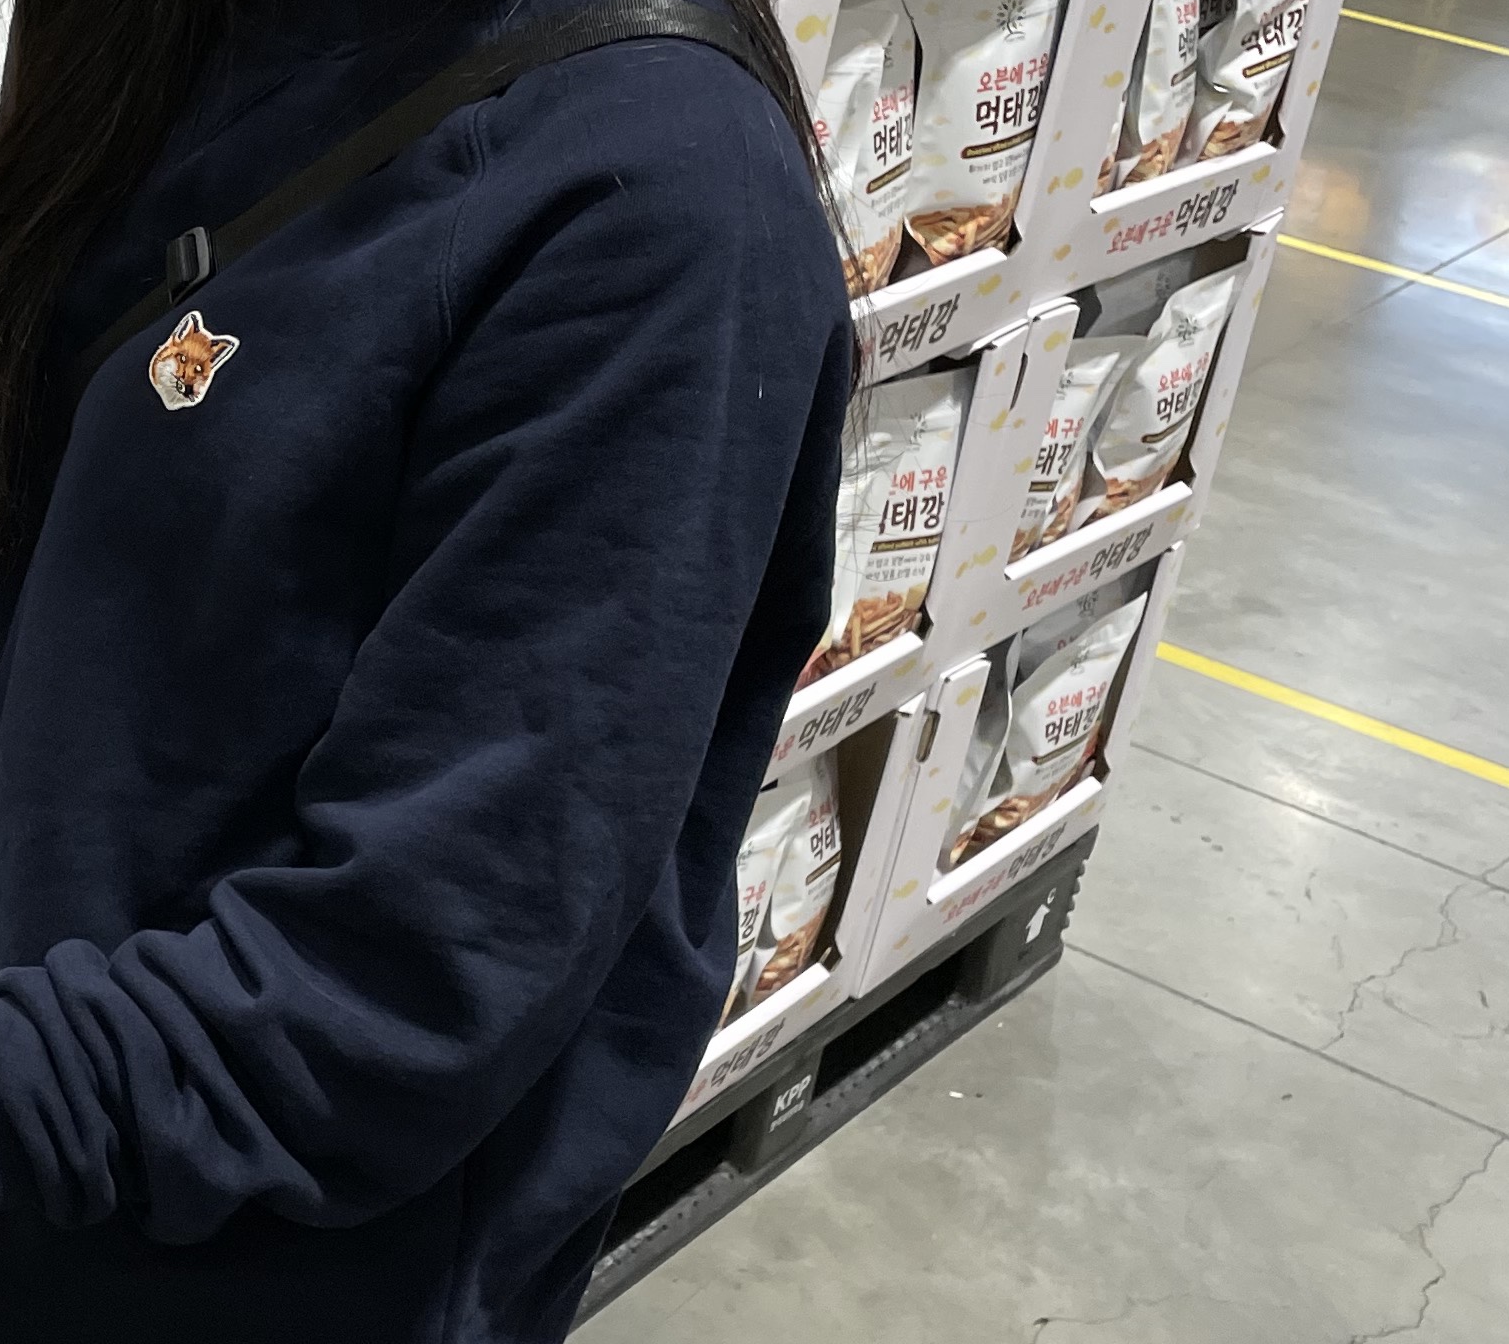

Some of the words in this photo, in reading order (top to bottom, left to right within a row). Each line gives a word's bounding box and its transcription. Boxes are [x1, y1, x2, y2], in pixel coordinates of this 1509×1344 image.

[871, 90, 899, 124] 오븐에
[976, 62, 1023, 94] 오븐에
[1105, 216, 1147, 256] 오븐에
[1146, 210, 1174, 240] 구운
[1174, 177, 1241, 237] 먹태깡
[878, 295, 959, 362] 먹태깡
[1021, 573, 1063, 611] 오븐에
[1062, 562, 1091, 591] 구운
[1087, 522, 1155, 580] 먹태깡
[798, 680, 878, 752] 먹태깡
[1045, 693, 1085, 719] 오븐에
[1006, 821, 1069, 882] 먹태깡
[710, 1016, 787, 1089] 먹태깡
[773, 1074, 812, 1117] KPP
